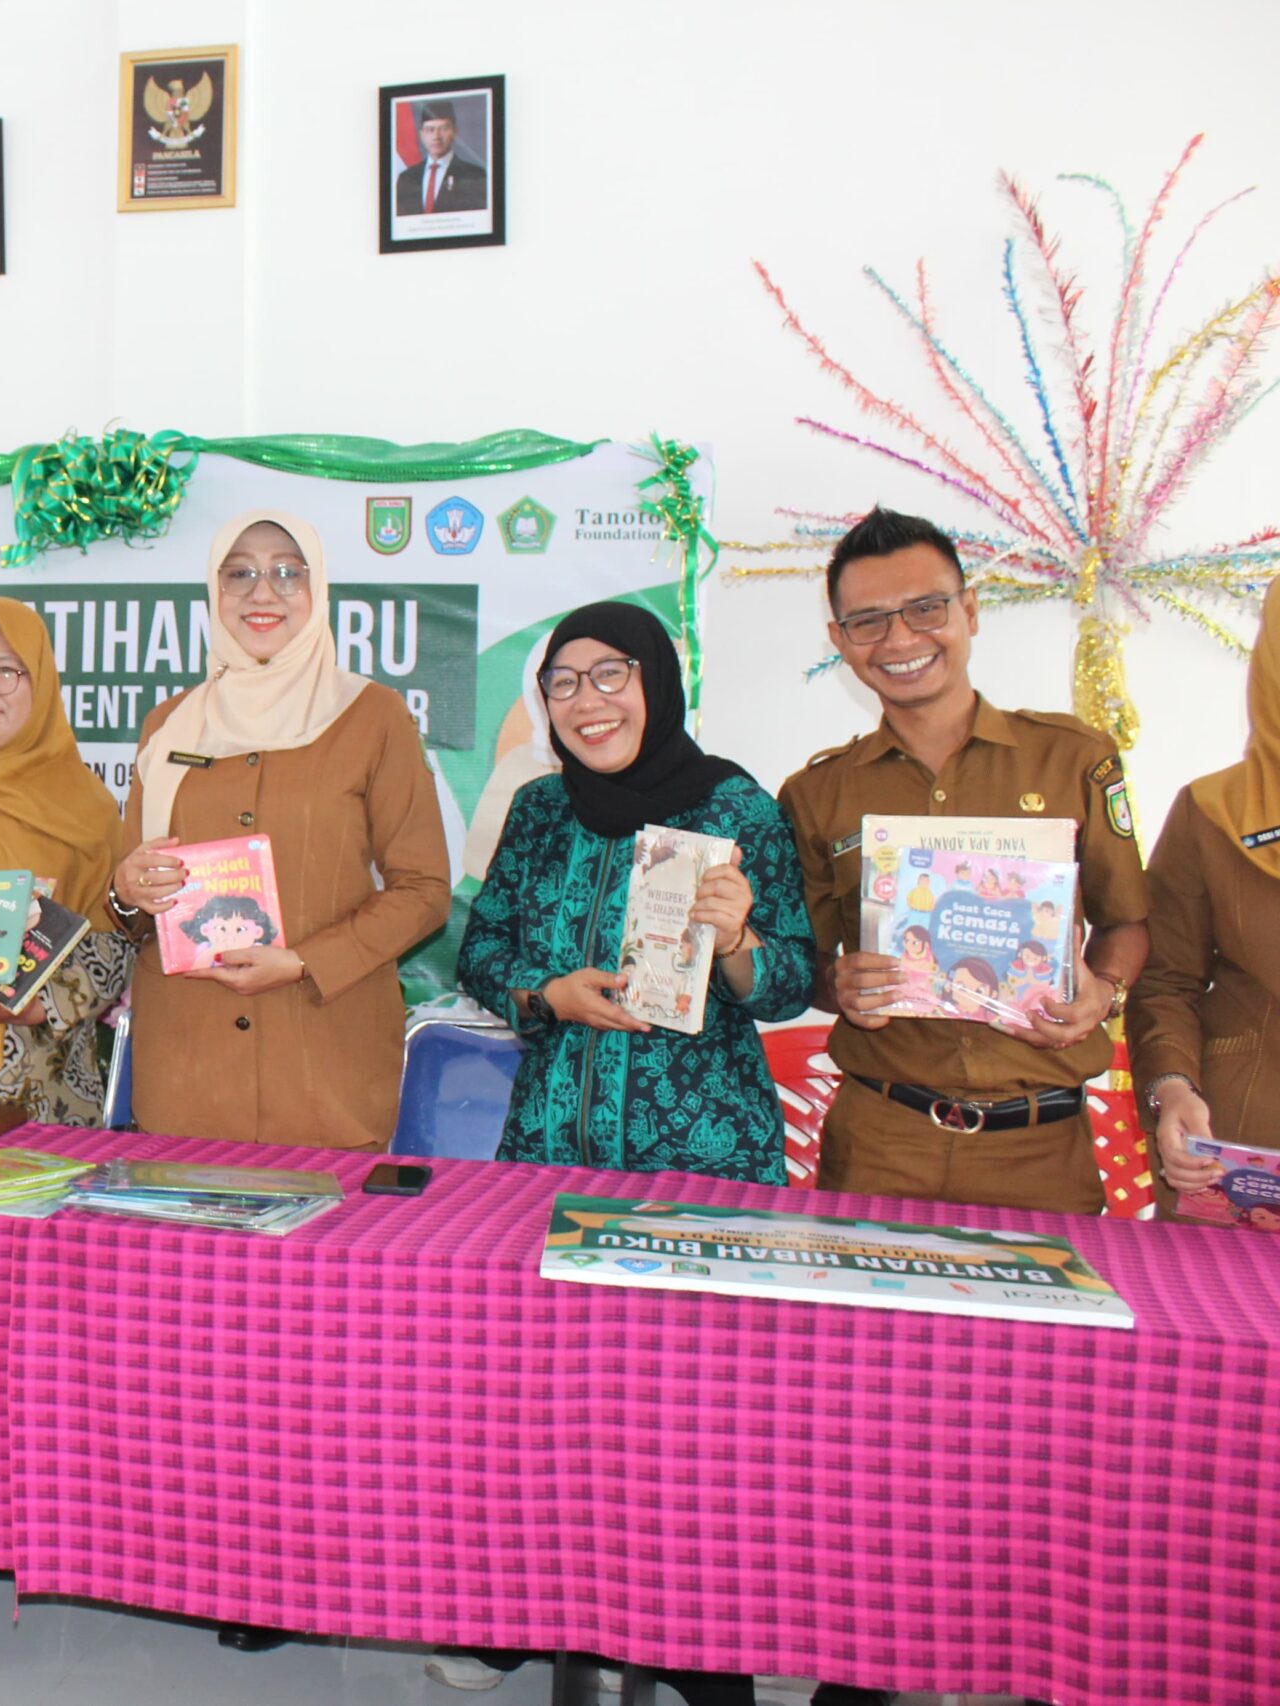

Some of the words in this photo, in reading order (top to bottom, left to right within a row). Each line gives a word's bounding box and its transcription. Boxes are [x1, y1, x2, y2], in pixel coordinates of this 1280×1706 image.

[576, 508, 662, 525] Tanoto
[575, 528, 661, 541] Foundation
[203, 875, 262, 893] Ngupil
[952, 902, 979, 914] Saat
[983, 906, 1012, 918] Caca
[940, 909, 1008, 932] Cemas
[937, 924, 1019, 950] Kecewa
[597, 1234, 702, 1256] BUKU
[716, 1244, 841, 1266] HIBAH
[854, 1255, 1054, 1283] BANTUAN
[1003, 1289, 1106, 1307] Apical
